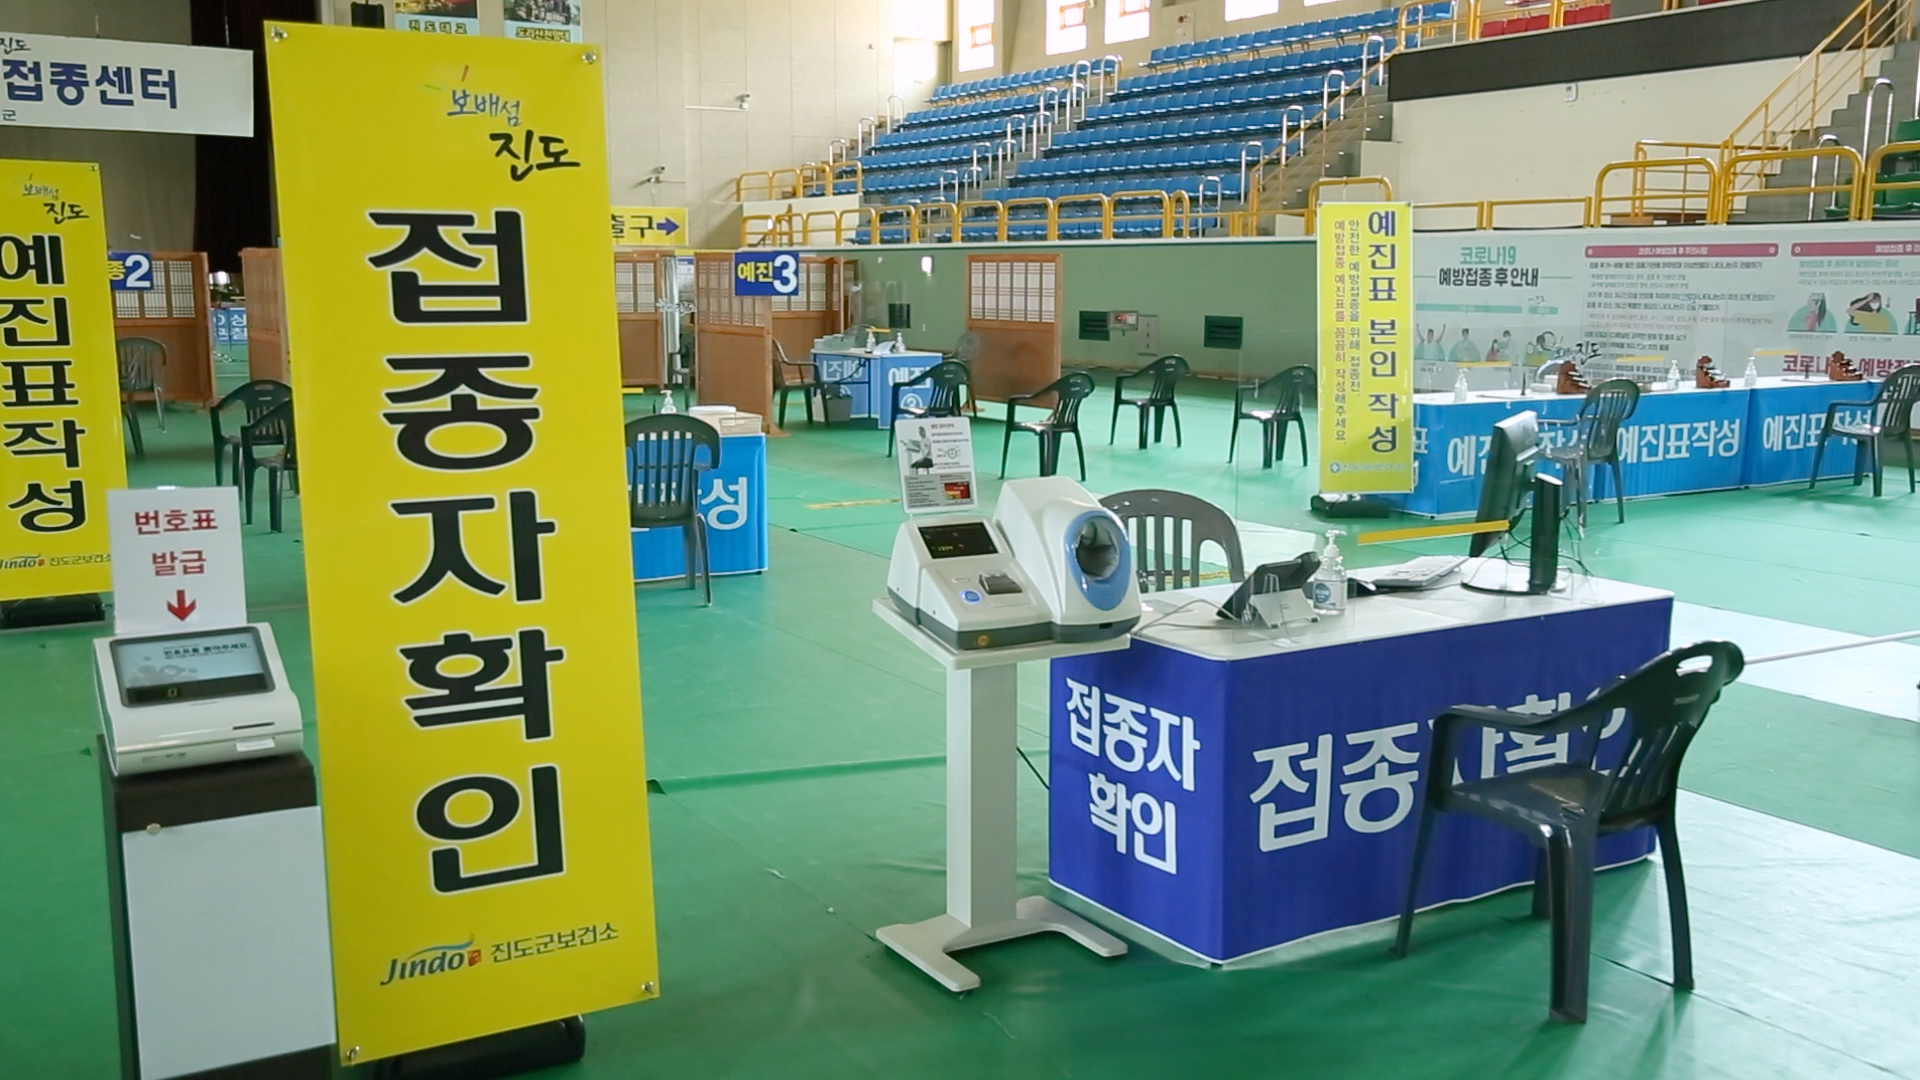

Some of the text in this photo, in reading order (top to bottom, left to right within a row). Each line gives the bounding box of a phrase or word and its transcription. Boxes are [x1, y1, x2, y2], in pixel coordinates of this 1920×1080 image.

[2, 58, 178, 109] 접종센터
[447, 89, 522, 127] 보배섬
[489, 129, 581, 182] 진도
[43, 201, 90, 225] 진도
[1439, 268, 1539, 287] 예방접종 후 안내
[1460, 246, 1517, 265] 코로나19
[1367, 211, 1399, 453] 예진표 본인 작성
[0, 233, 87, 534] 예진표작성
[1616, 418, 1740, 464] 예진표작성
[134, 509, 219, 535] 번호표
[151, 550, 207, 577] 발급
[365, 208, 568, 894] 접종자확인
[1066, 677, 1201, 792] 접종자
[1088, 772, 1178, 875] 확인
[491, 922, 619, 964] 진도군보건소
